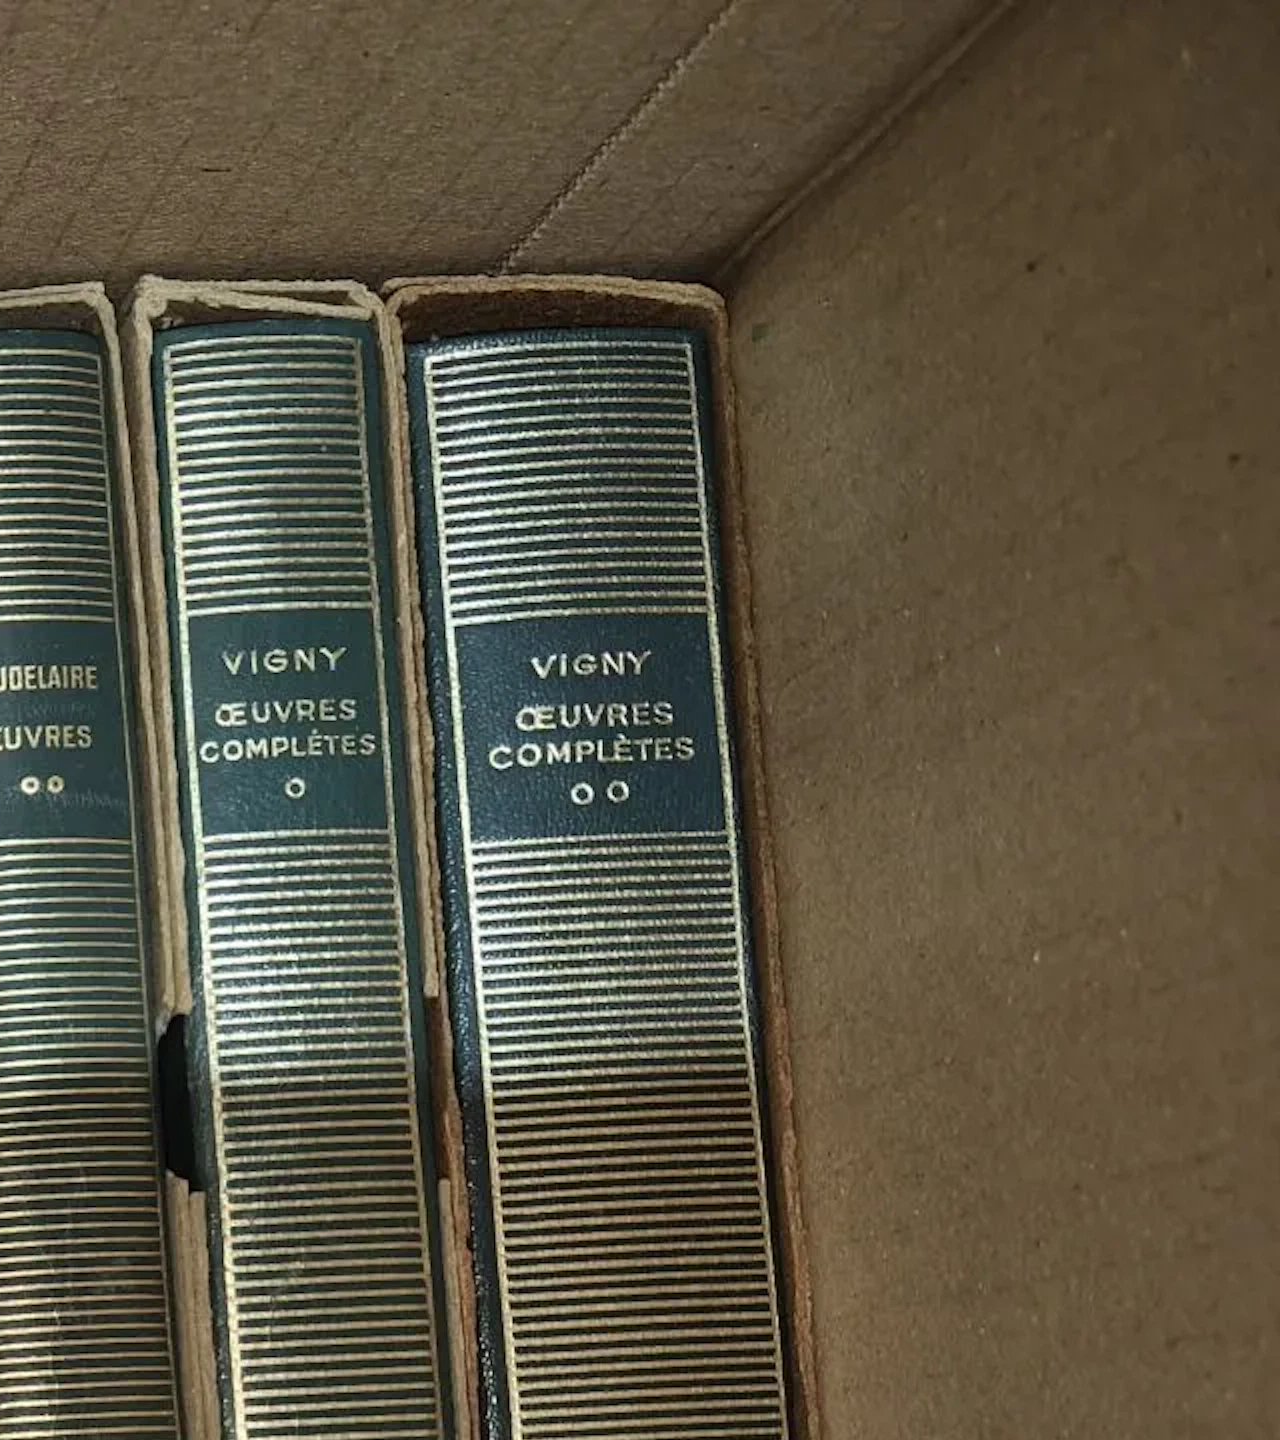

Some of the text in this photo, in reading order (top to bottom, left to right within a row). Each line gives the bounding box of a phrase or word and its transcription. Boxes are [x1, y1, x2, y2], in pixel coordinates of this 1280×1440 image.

[221, 647, 348, 676] VIGNY
[531, 651, 651, 679] VIGNY
[215, 698, 357, 727] ŒUVRES
[515, 702, 674, 732] ŒUVRES
[489, 734, 695, 770] COMPLÈTES
